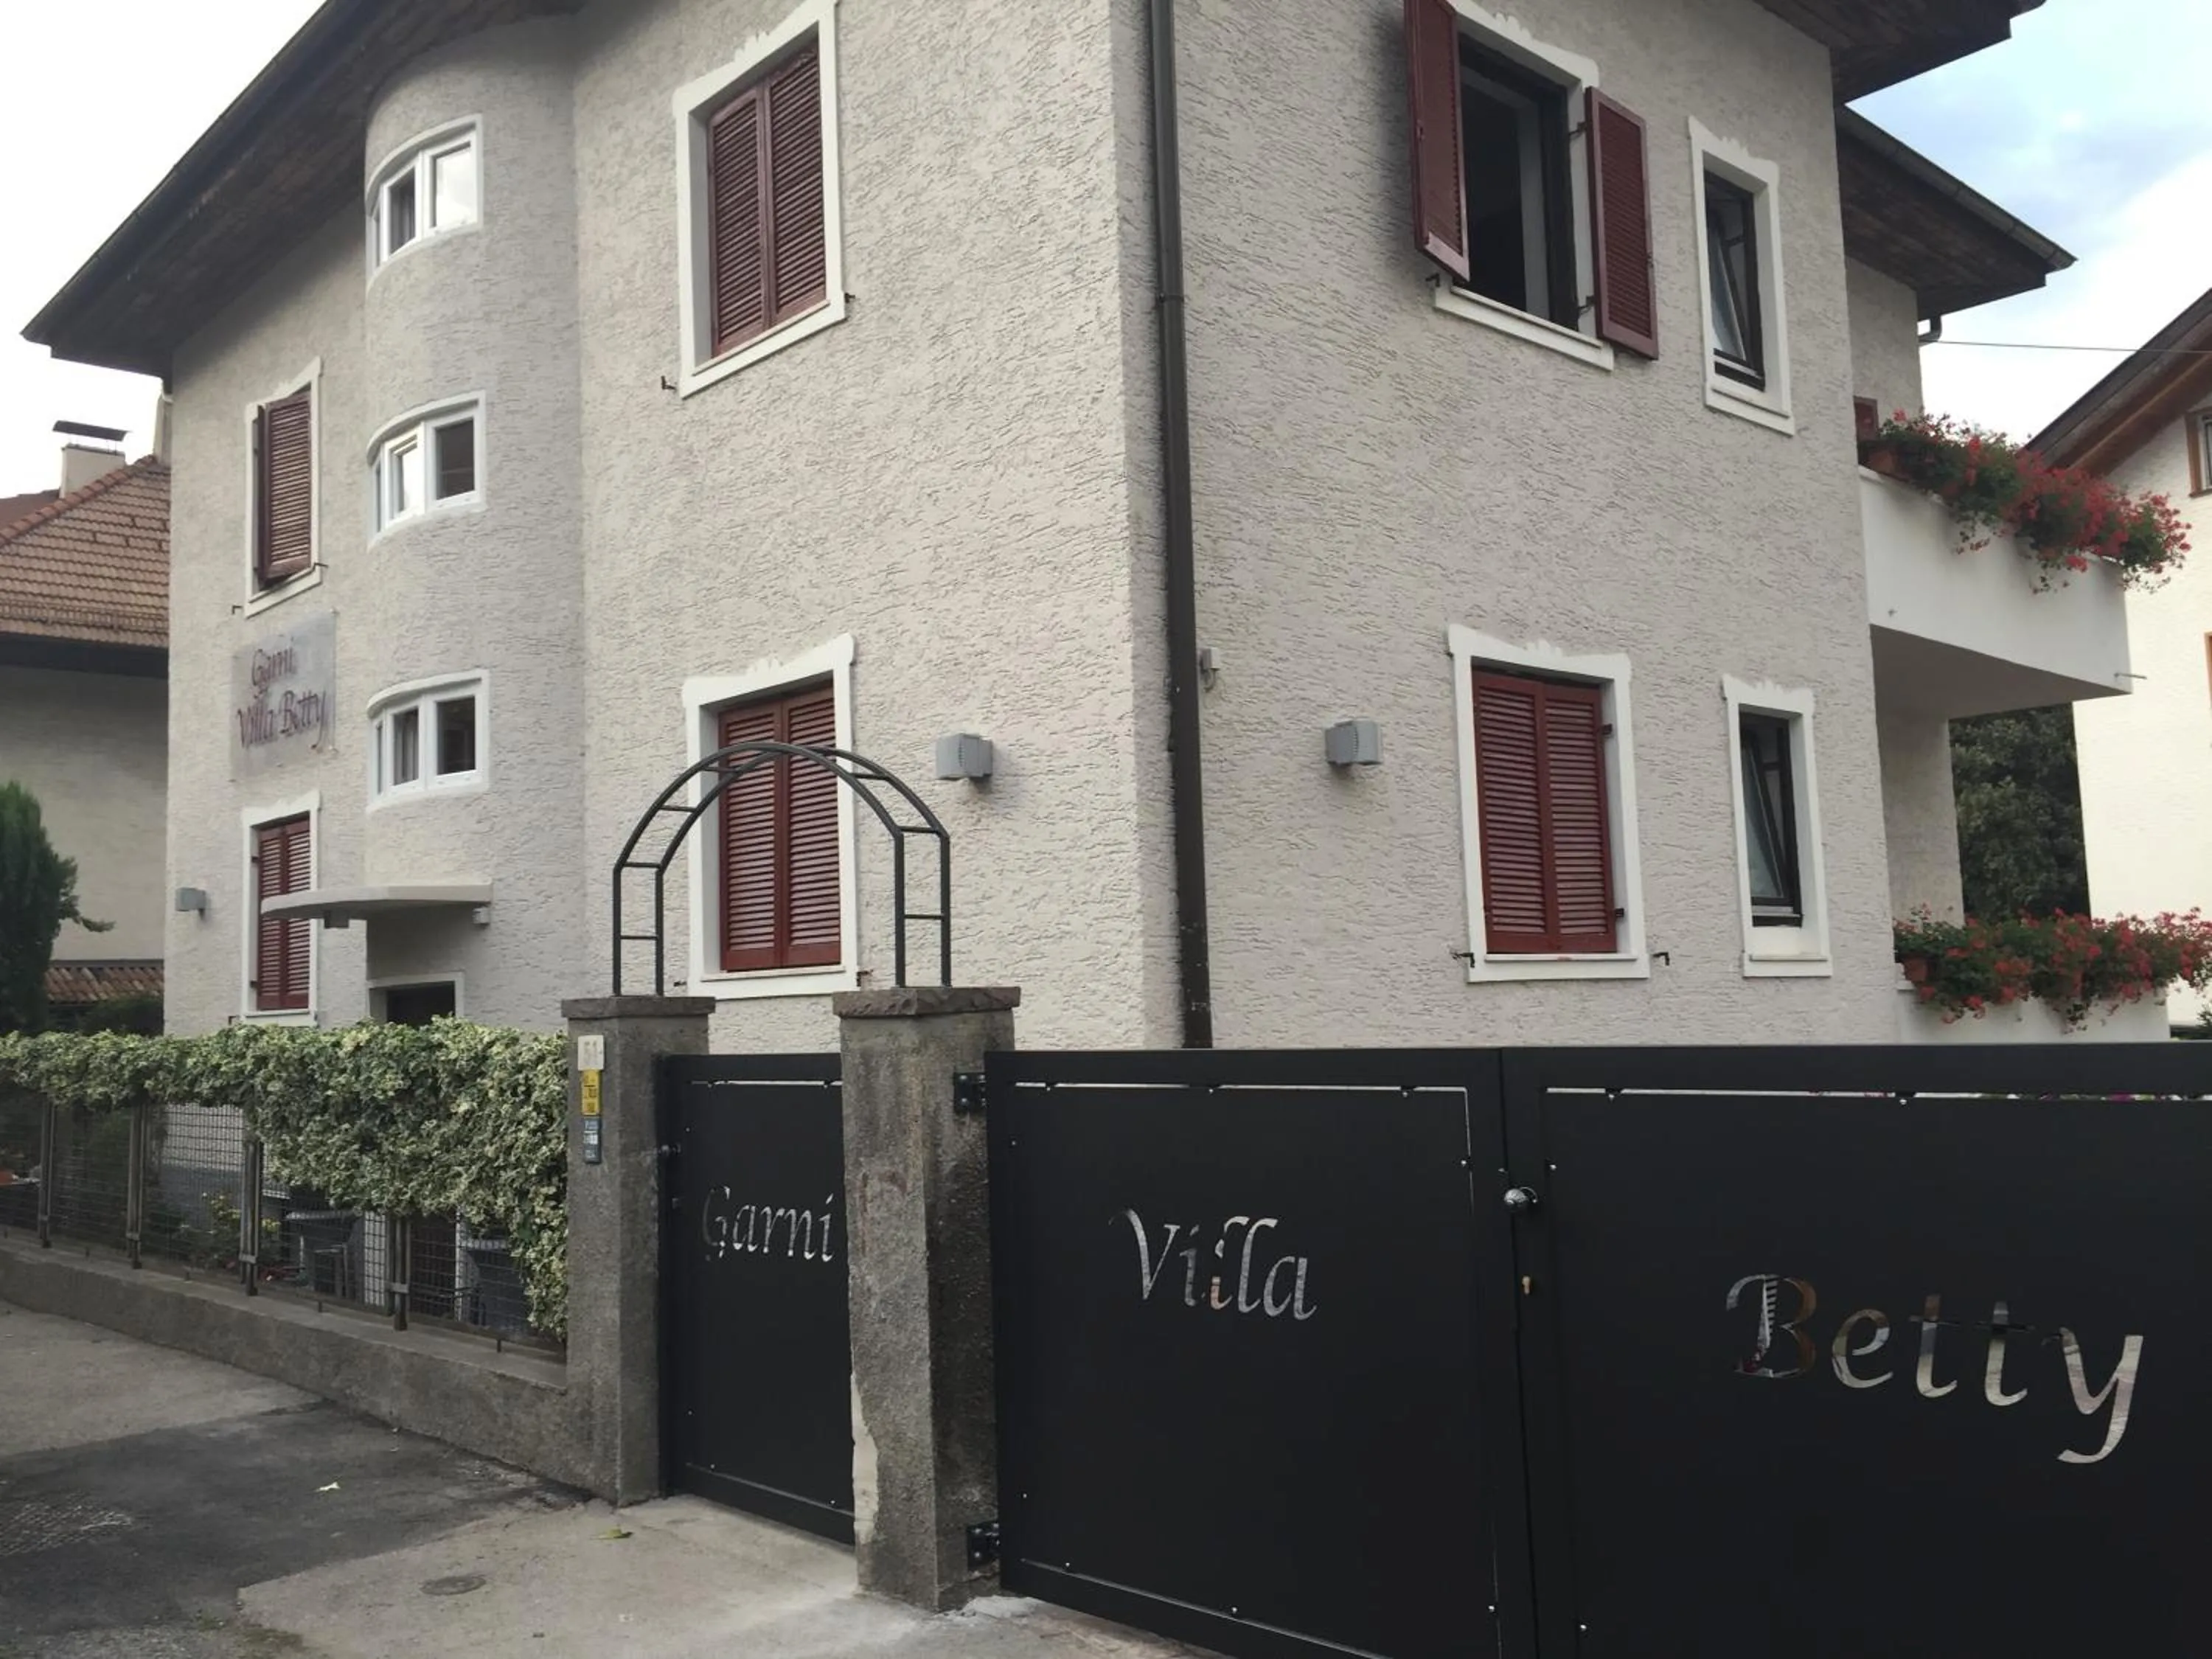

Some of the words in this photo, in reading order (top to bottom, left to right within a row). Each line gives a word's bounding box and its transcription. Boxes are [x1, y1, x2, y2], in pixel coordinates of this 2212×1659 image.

[251, 635, 297, 695] Garni
[237, 694, 279, 748] Villa
[279, 689, 327, 750] Betty
[703, 1185, 834, 1262] Garni
[1107, 1208, 1317, 1321] Villa
[1725, 1273, 2144, 1464] Betty
